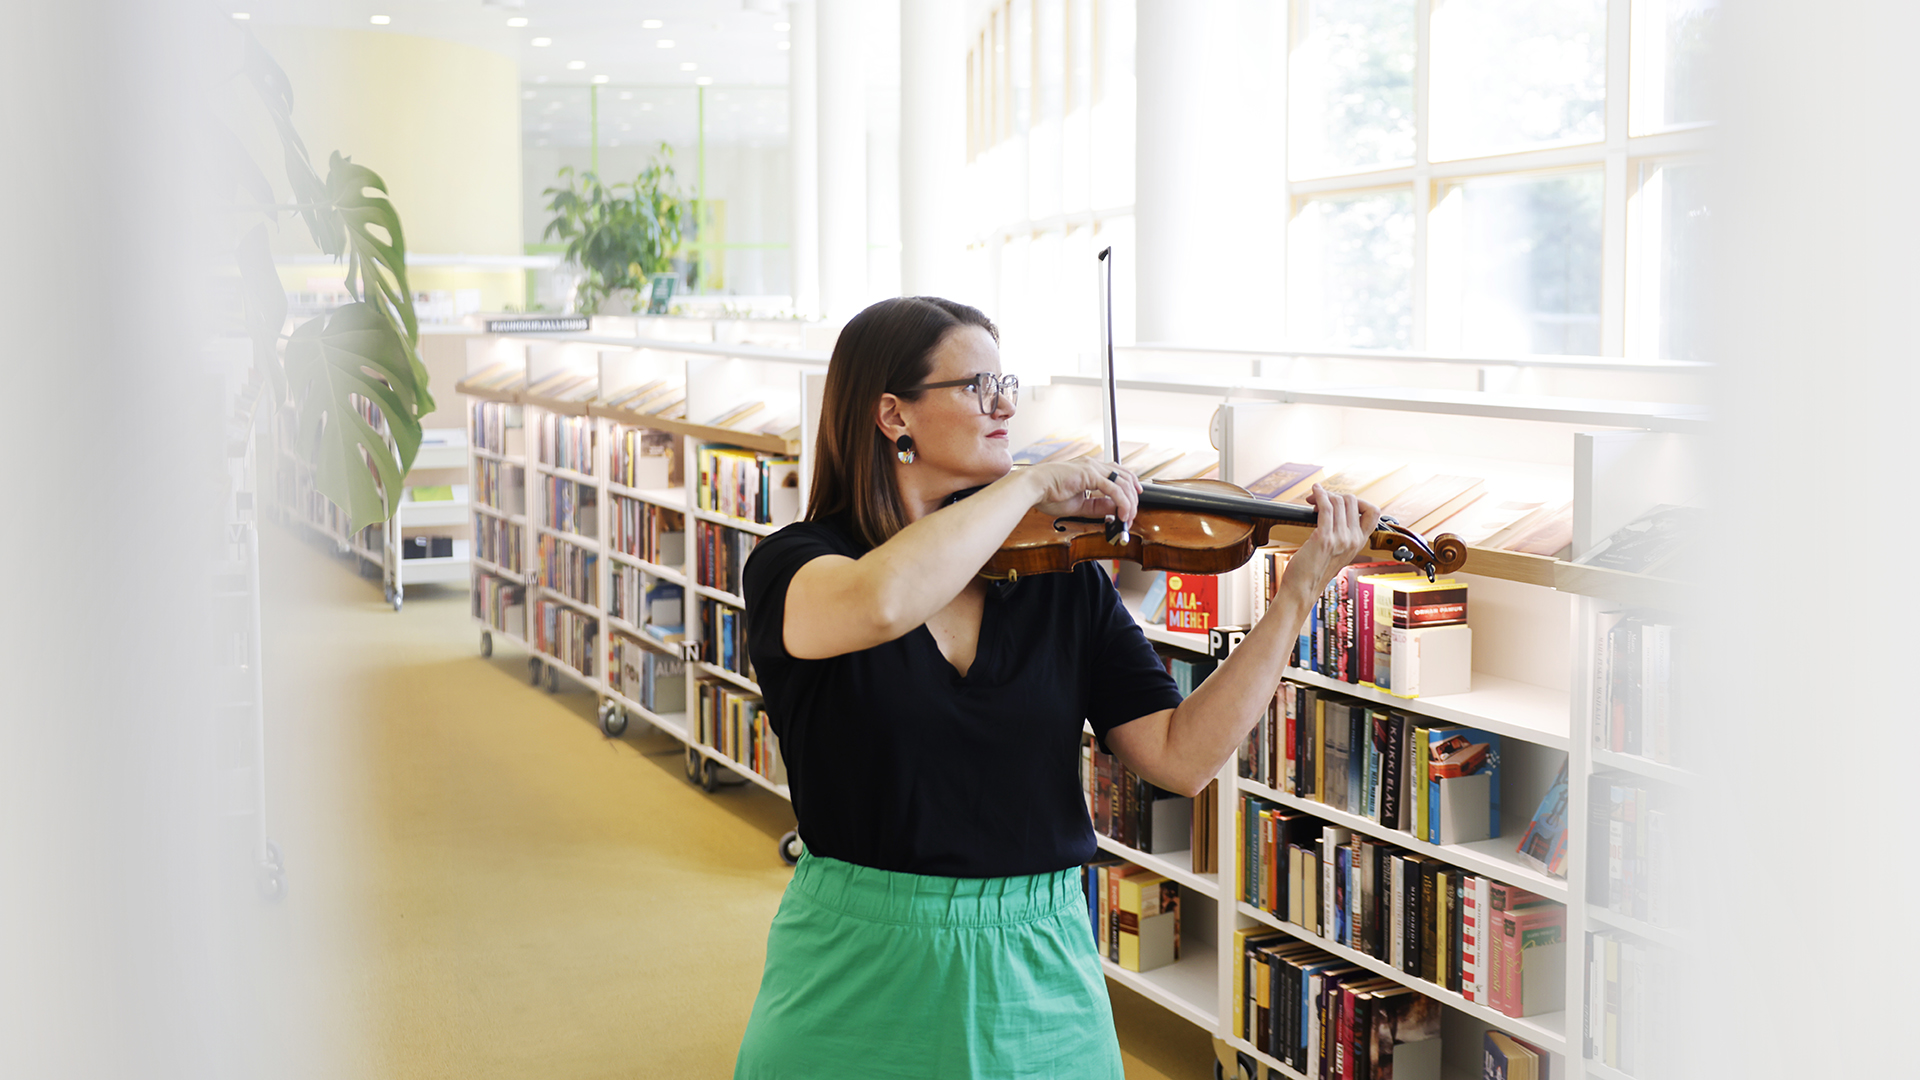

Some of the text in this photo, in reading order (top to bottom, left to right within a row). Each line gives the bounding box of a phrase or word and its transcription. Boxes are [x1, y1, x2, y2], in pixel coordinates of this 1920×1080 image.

[1169, 591, 1202, 610] KALA-
[1169, 610, 1210, 630] MIEHET
[1209, 630, 1223, 657] P
[1383, 725, 1398, 819] KAIKKI ELÄVÄ
[1422, 873, 1434, 903] 1827
[1409, 885, 1417, 950] MIKE POHJOLA
